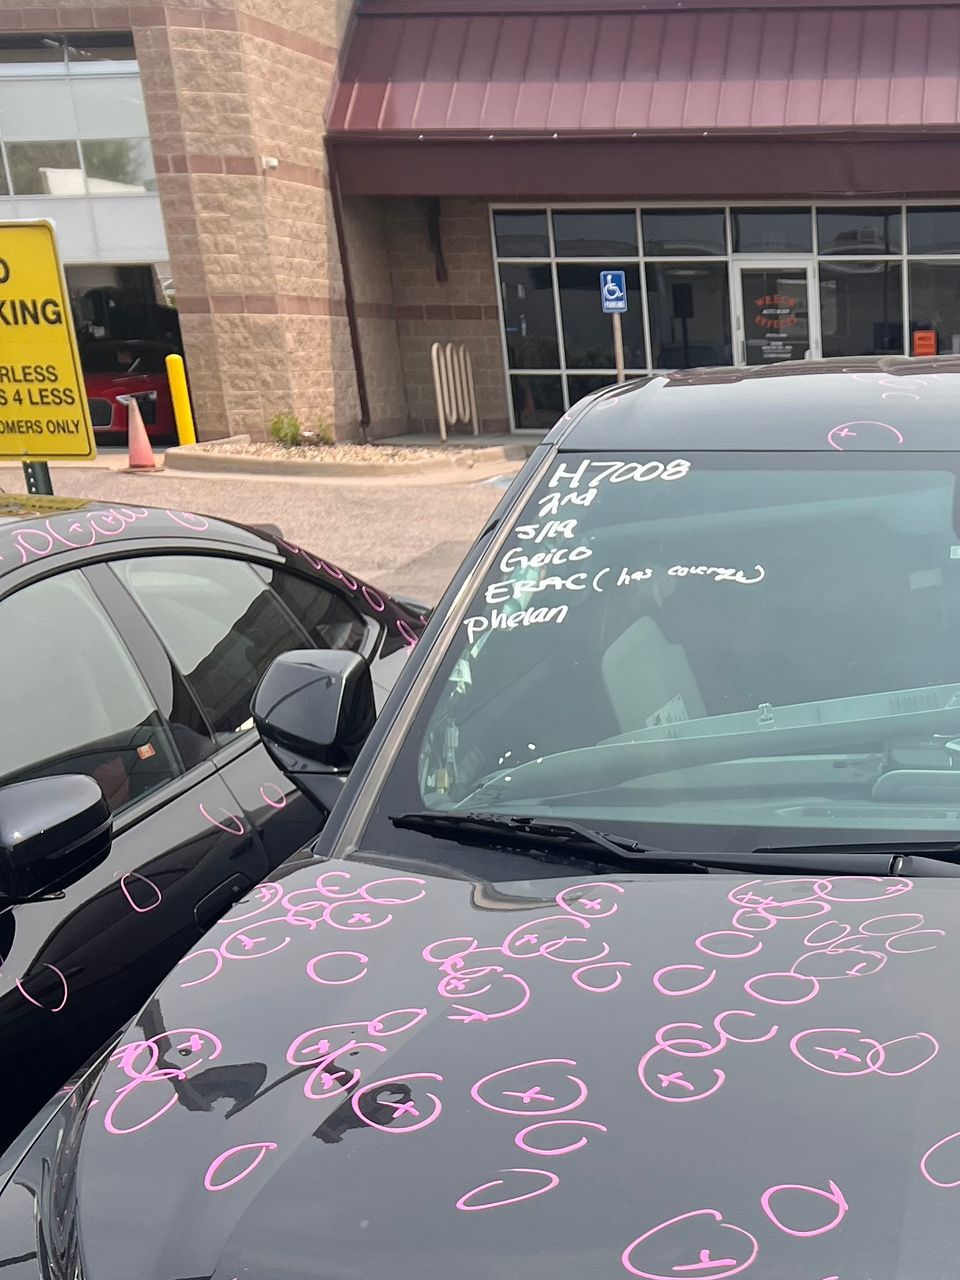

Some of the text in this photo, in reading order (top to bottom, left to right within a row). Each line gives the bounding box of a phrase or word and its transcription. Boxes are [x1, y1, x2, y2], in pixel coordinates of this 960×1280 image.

[12, 389, 23, 405] 4
[28, 387, 76, 406] LESS
[46, 419, 80, 434] ONLY
[548, 459, 691, 488] H7008
